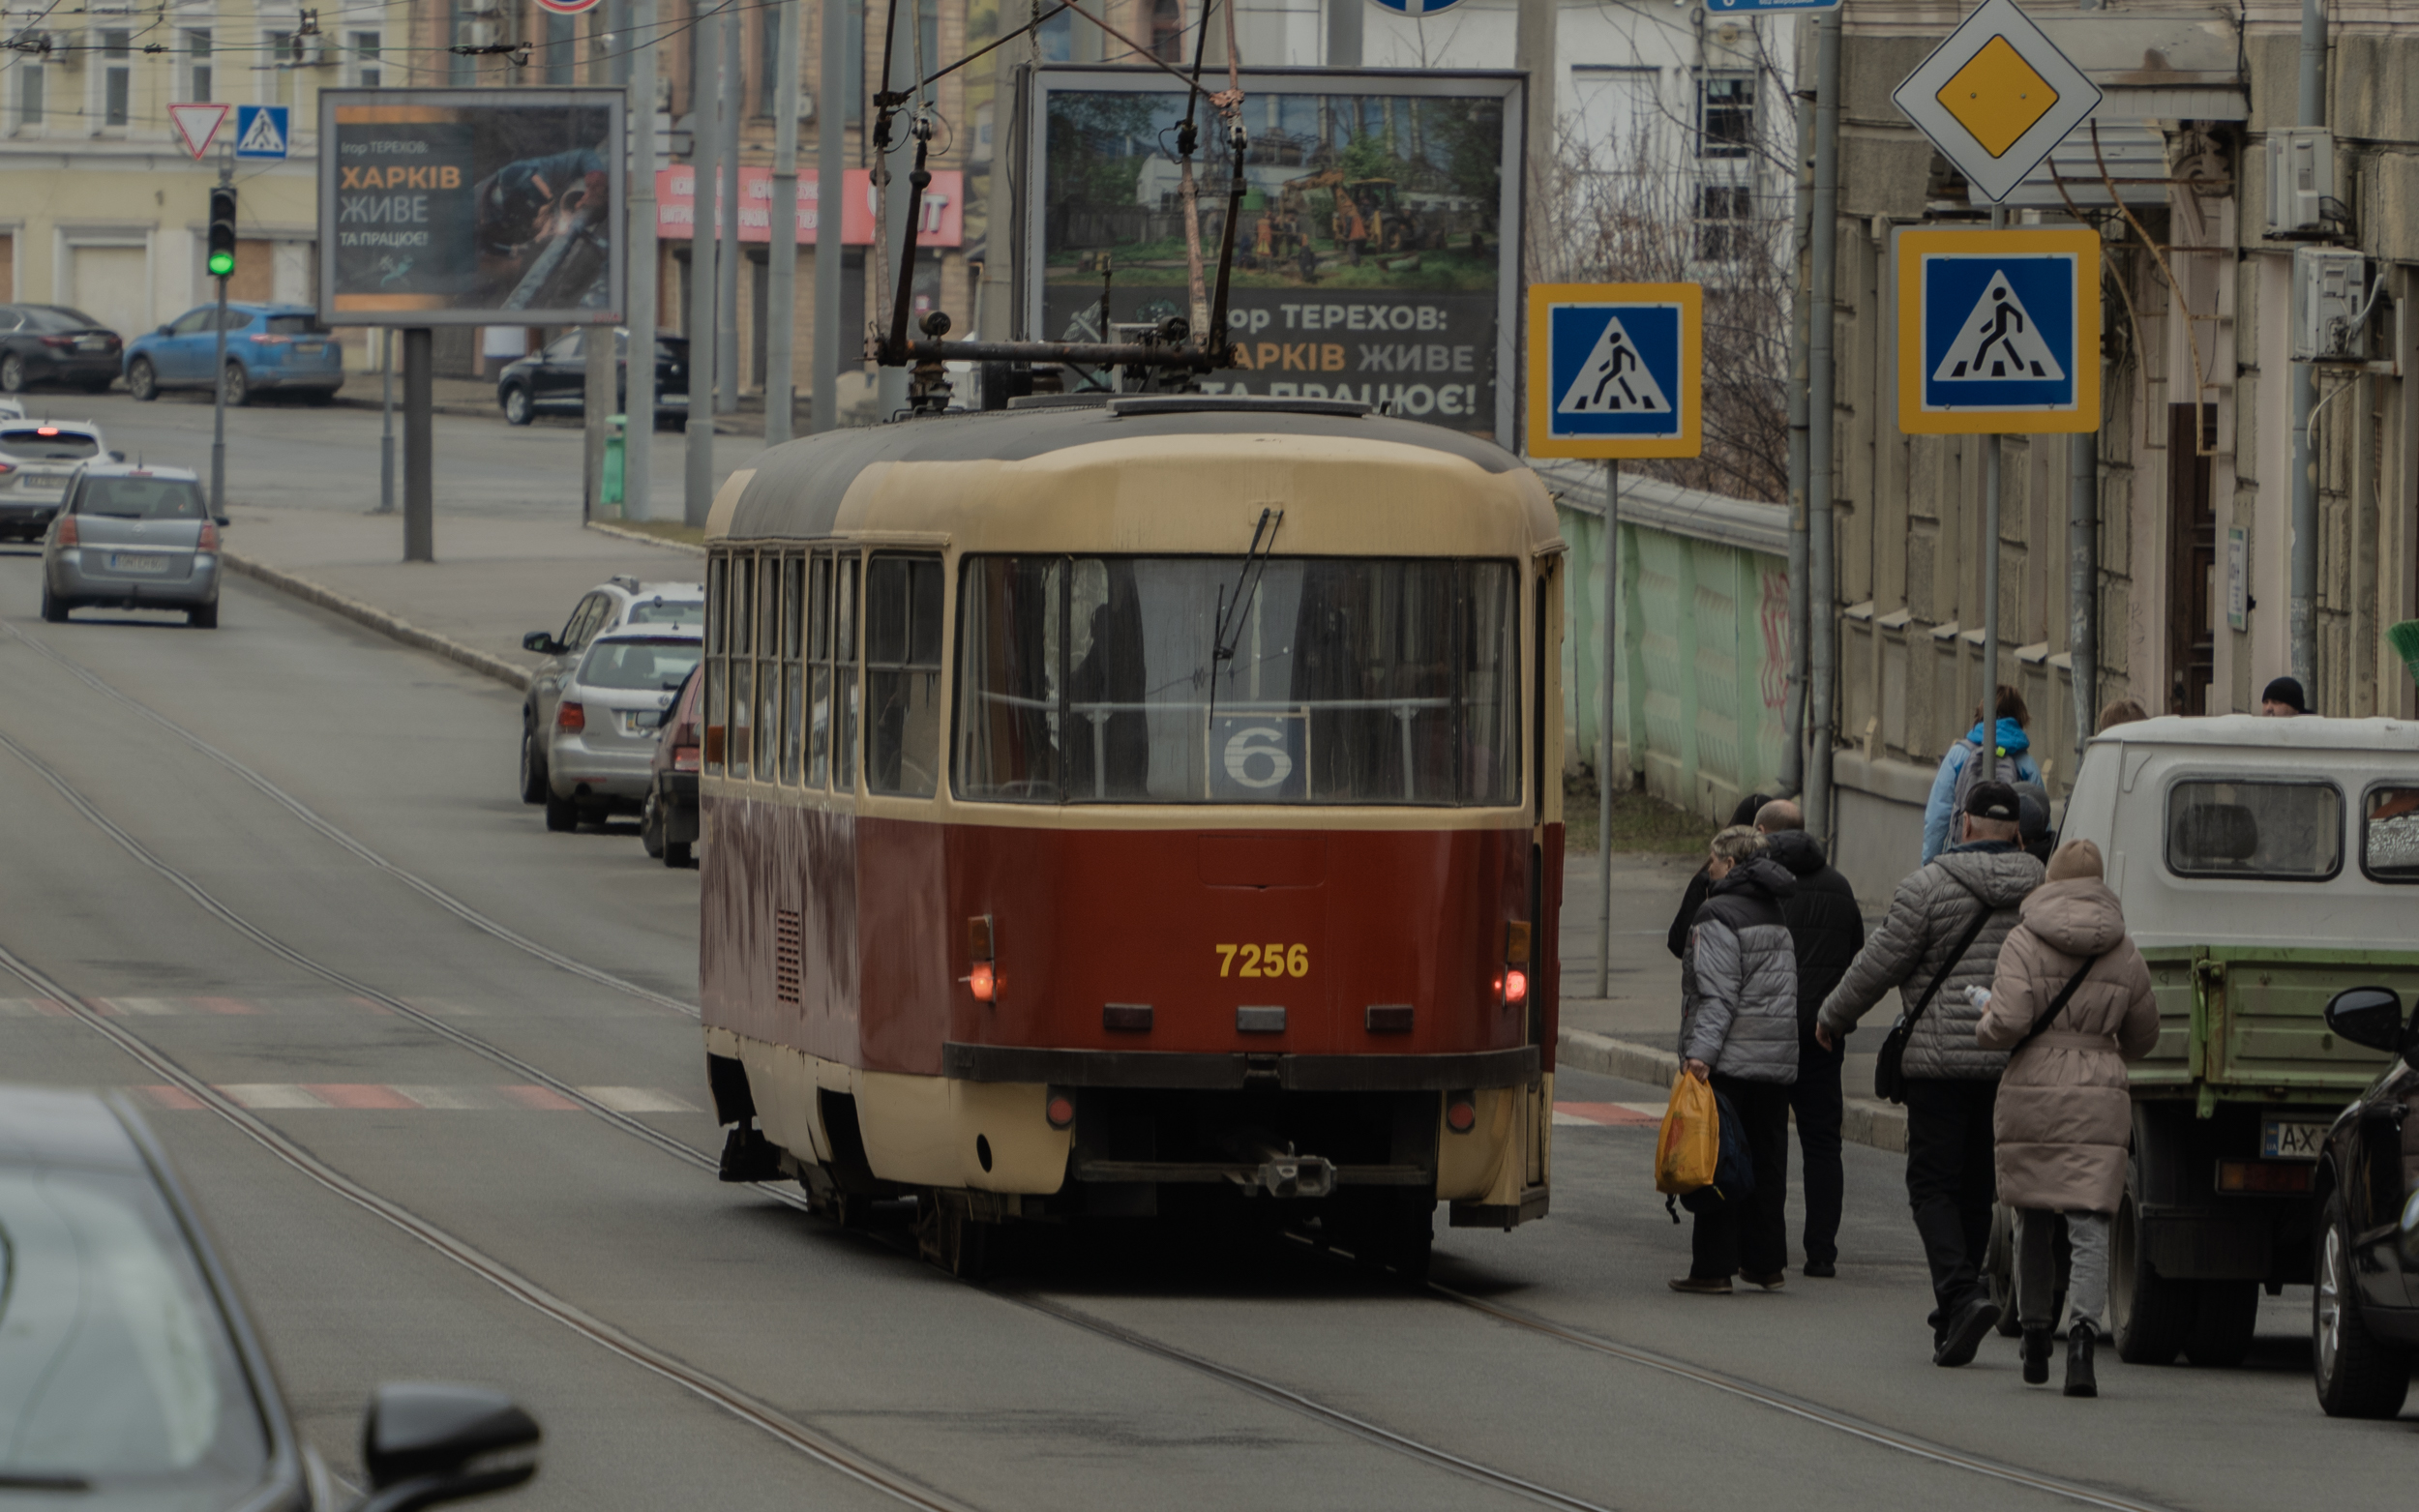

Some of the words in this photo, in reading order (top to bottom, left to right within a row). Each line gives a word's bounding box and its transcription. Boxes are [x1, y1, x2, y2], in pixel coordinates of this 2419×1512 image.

[341, 165, 462, 190] ХАРКІВ
[340, 195, 429, 223] ЖИВЕ
[339, 231, 357, 246] ТА
[360, 231, 429, 249] ПРАЦЮЄ!
[1227, 308, 1270, 334] ор
[1280, 304, 1448, 331] ТЕРЕХОВ:
[1233, 341, 1346, 371] АРКІВ
[1357, 343, 1475, 372] ЖИВЕ
[1224, 726, 1292, 788] 6
[1215, 942, 1309, 978] 7256
